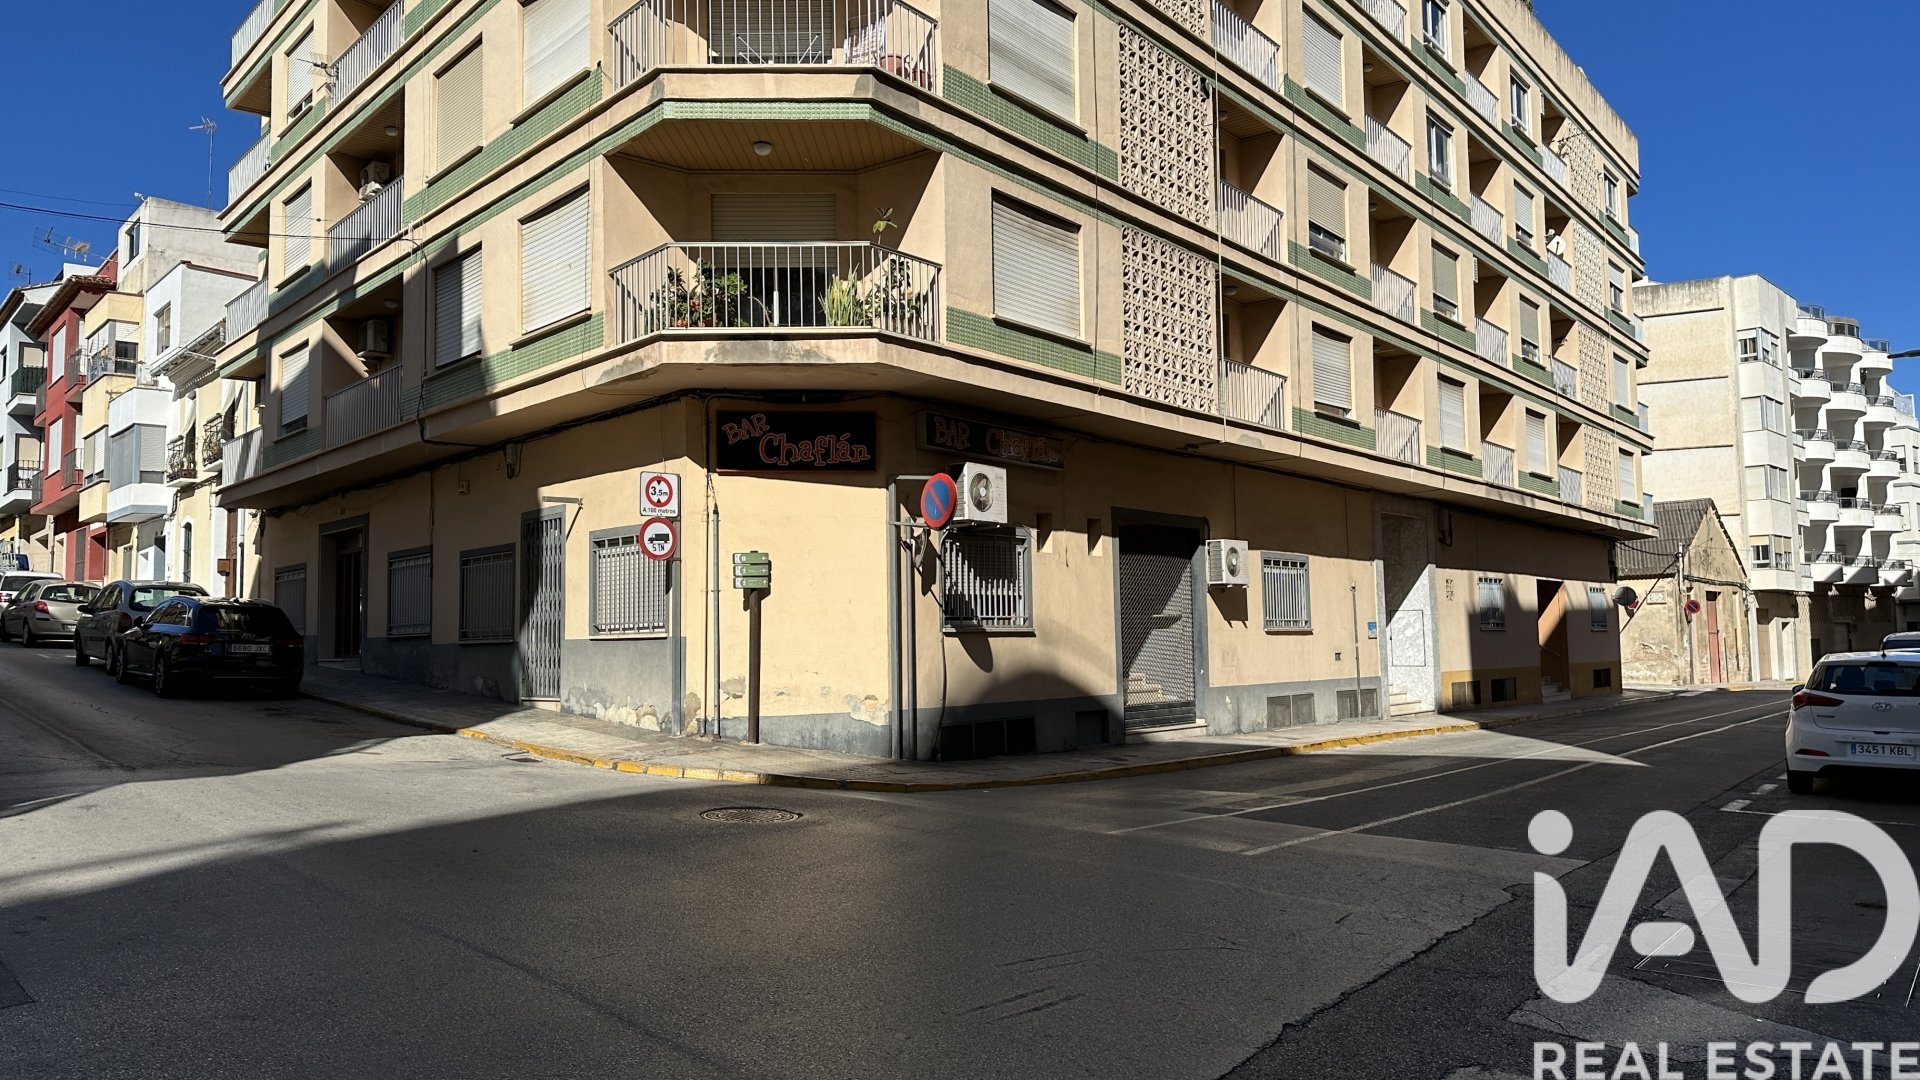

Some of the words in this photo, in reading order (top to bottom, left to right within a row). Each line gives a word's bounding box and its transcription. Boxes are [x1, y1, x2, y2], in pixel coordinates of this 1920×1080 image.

[721, 413, 770, 444] BAR
[933, 416, 971, 450] BAR
[758, 432, 871, 467] Chaflán
[1858, 744, 1886, 755] 3451
[1889, 746, 1912, 757] KBL
